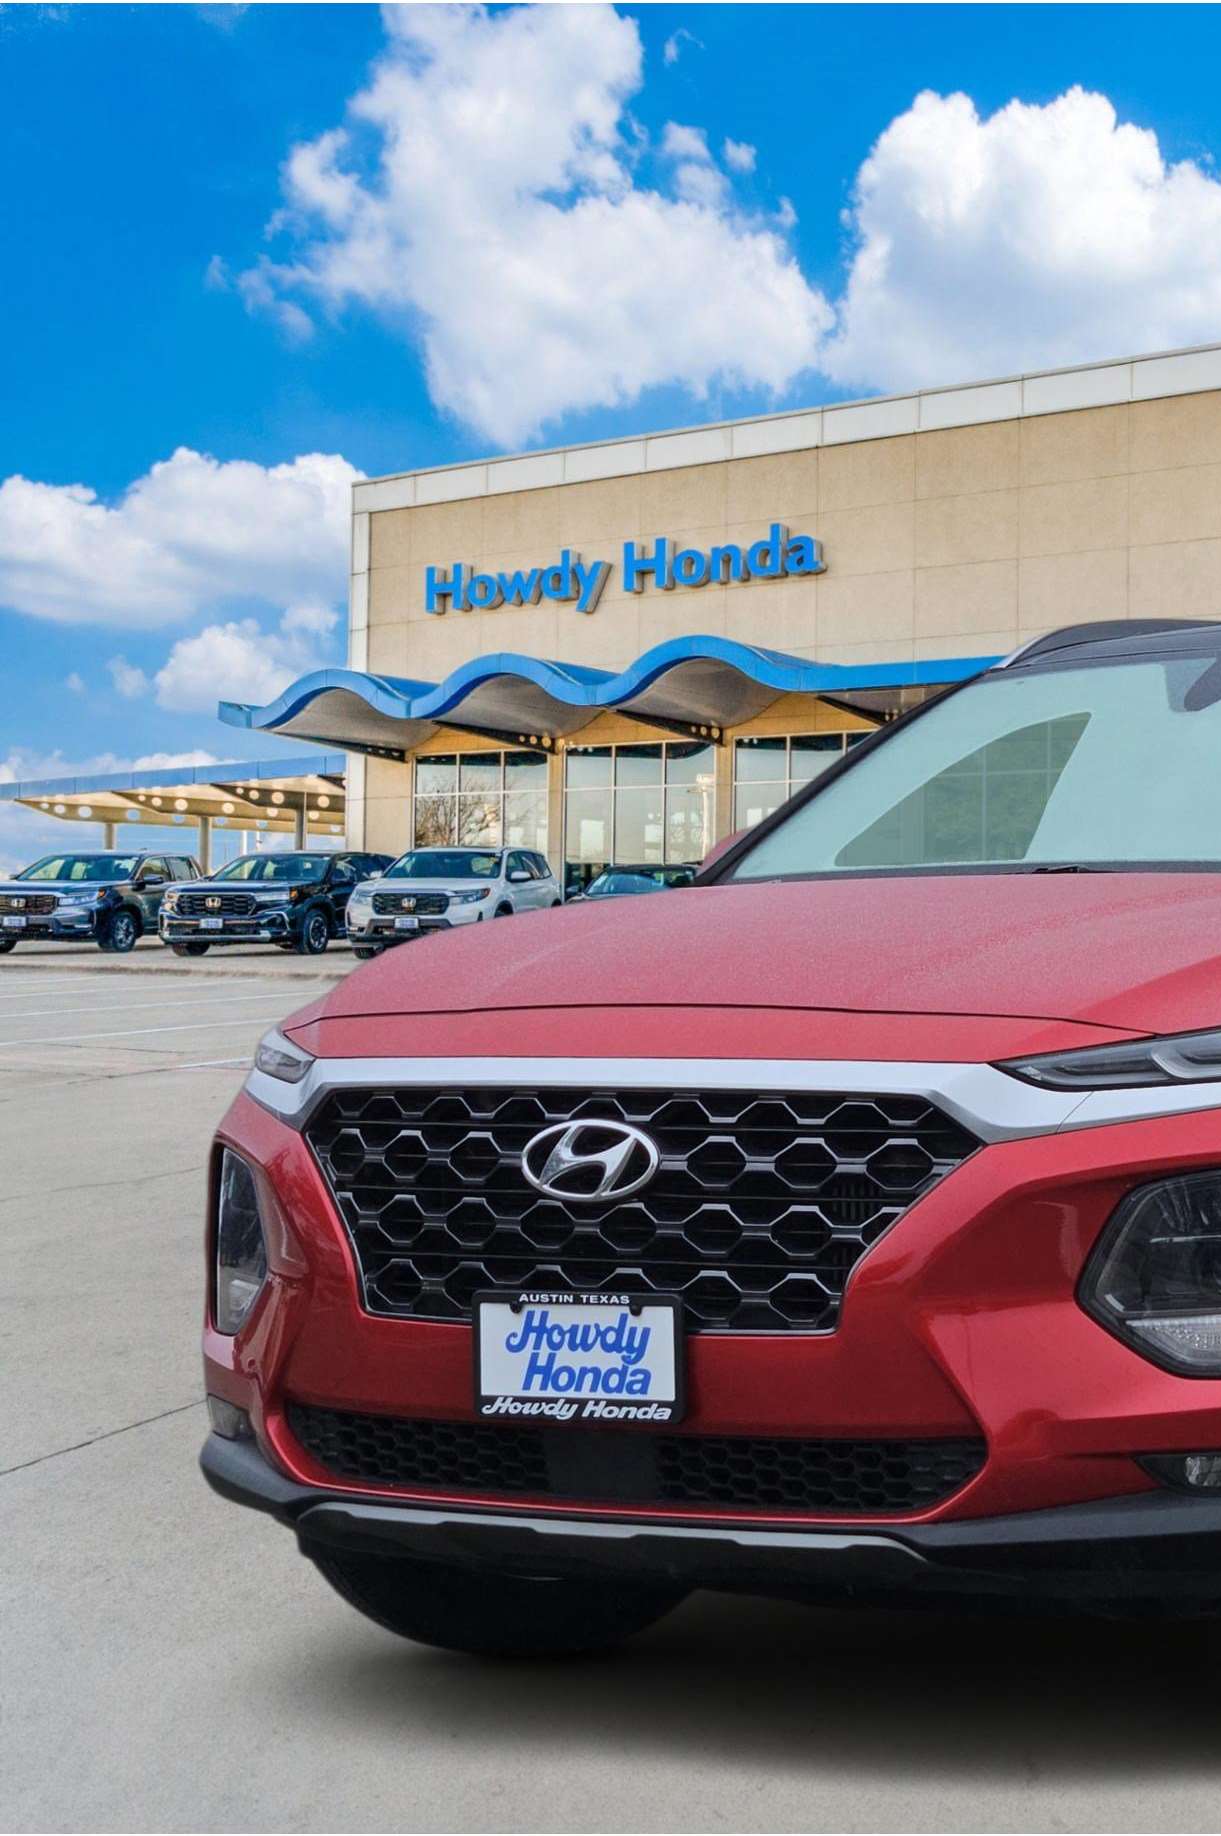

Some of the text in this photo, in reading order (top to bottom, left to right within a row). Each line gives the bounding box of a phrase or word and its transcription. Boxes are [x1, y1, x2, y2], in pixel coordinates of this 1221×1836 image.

[425, 523, 827, 614] Howdy Honda
[519, 1293, 630, 1305] AUSTIN TEXAS
[505, 1310, 651, 1365] Howdy
[522, 1352, 652, 1395] Honda
[481, 1396, 673, 1421] Howdy Honda
